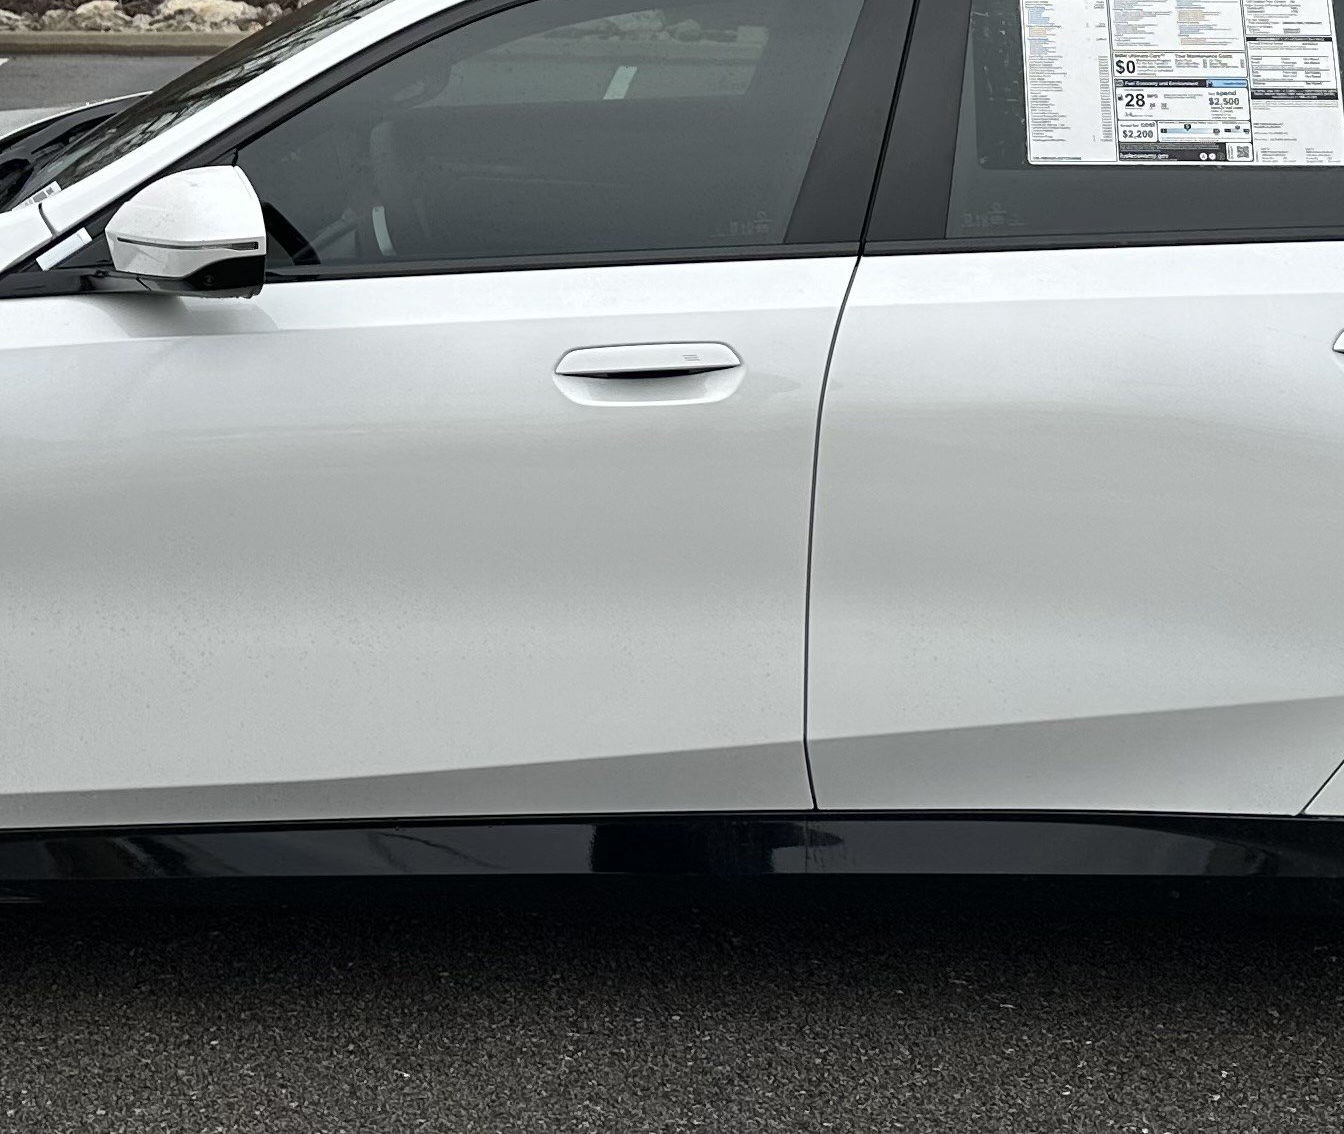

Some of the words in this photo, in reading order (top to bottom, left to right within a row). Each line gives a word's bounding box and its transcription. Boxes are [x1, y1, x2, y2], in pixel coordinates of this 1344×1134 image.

[1115, 59, 1136, 75] $0
[1124, 93, 1146, 107] 28
[1208, 97, 1240, 107] $2,500
[1122, 129, 1154, 139] $2,200
